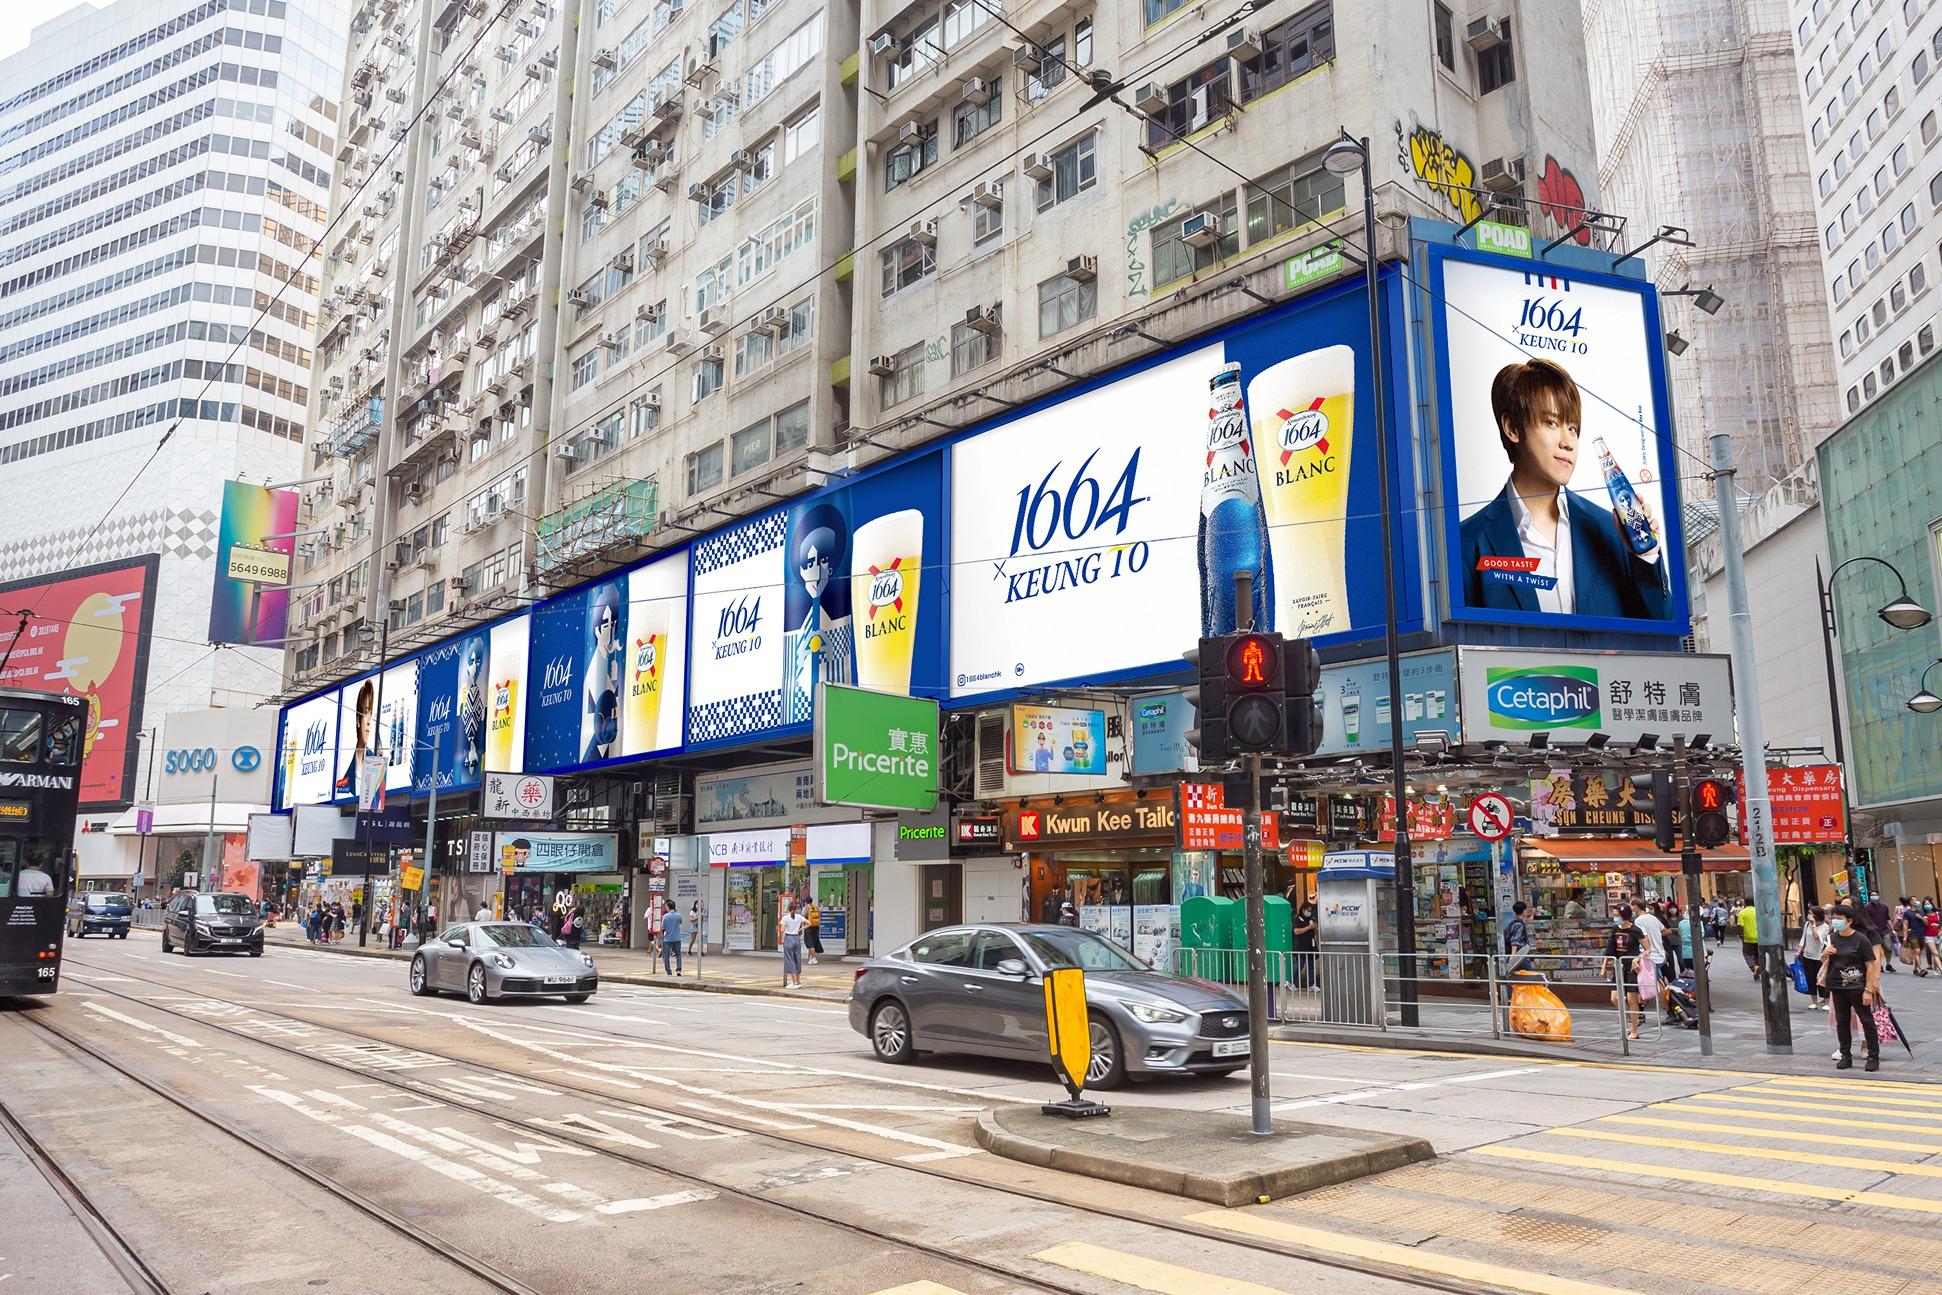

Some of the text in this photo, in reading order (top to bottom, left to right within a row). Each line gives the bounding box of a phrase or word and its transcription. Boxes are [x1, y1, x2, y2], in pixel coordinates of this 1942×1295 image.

[1479, 224, 1528, 251] POAD
[1520, 296, 1585, 337] 1664
[1520, 334, 1588, 355] KEUNG TO
[1200, 417, 1244, 446] 1664
[1284, 419, 1322, 447] 1664
[1204, 458, 1255, 487] BLANC
[1276, 456, 1335, 487] BLANC
[1010, 446, 1147, 558] 1664
[230, 562, 287, 579] 5649 6988
[1005, 541, 1149, 604] KEUNG TO
[1511, 560, 1533, 568] TASTE
[871, 578, 899, 601] 1664
[1494, 572, 1514, 581] WITH
[1526, 577, 1549, 587] TWIST
[717, 594, 763, 639] 1664
[865, 615, 907, 639] BLANC
[637, 649, 655, 667] 1664
[714, 639, 748, 660] KEUNG
[543, 653, 573, 690] 1664
[541, 689, 572, 707] KEUNG TO
[632, 680, 657, 697] BLANC
[1340, 685, 1346, 695] 3
[1496, 685, 1594, 715] Cetaphil
[1609, 680, 1701, 707] 舒特膚
[60, 696, 80, 706] 165
[428, 692, 452, 722] 1664
[492, 717, 511, 730] BLANC
[1612, 708, 1703, 723] 醫學潔膚護膚品牌
[303, 719, 327, 757] 1664
[427, 722, 443, 737] KEUG
[888, 727, 929, 755] 實惠
[165, 747, 216, 774] SOGO
[833, 742, 929, 778] Pricerite
[1105, 751, 1124, 763] ilor
[15, 774, 73, 790] ARMANI
[521, 781, 542, 804] 藥
[1768, 784, 1836, 795] eung Dispensary
[487, 778, 510, 815] 龍新
[1047, 814, 1091, 834] Kwun
[1097, 810, 1133, 831] Kee
[1135, 805, 1174, 829] Tailo
[1556, 811, 1577, 825] SUN
[1586, 811, 1625, 824] CHEUNG
[900, 825, 945, 840] Pricerite
[536, 842, 604, 857] 四眼仔開倉
[37, 967, 56, 978] 165
